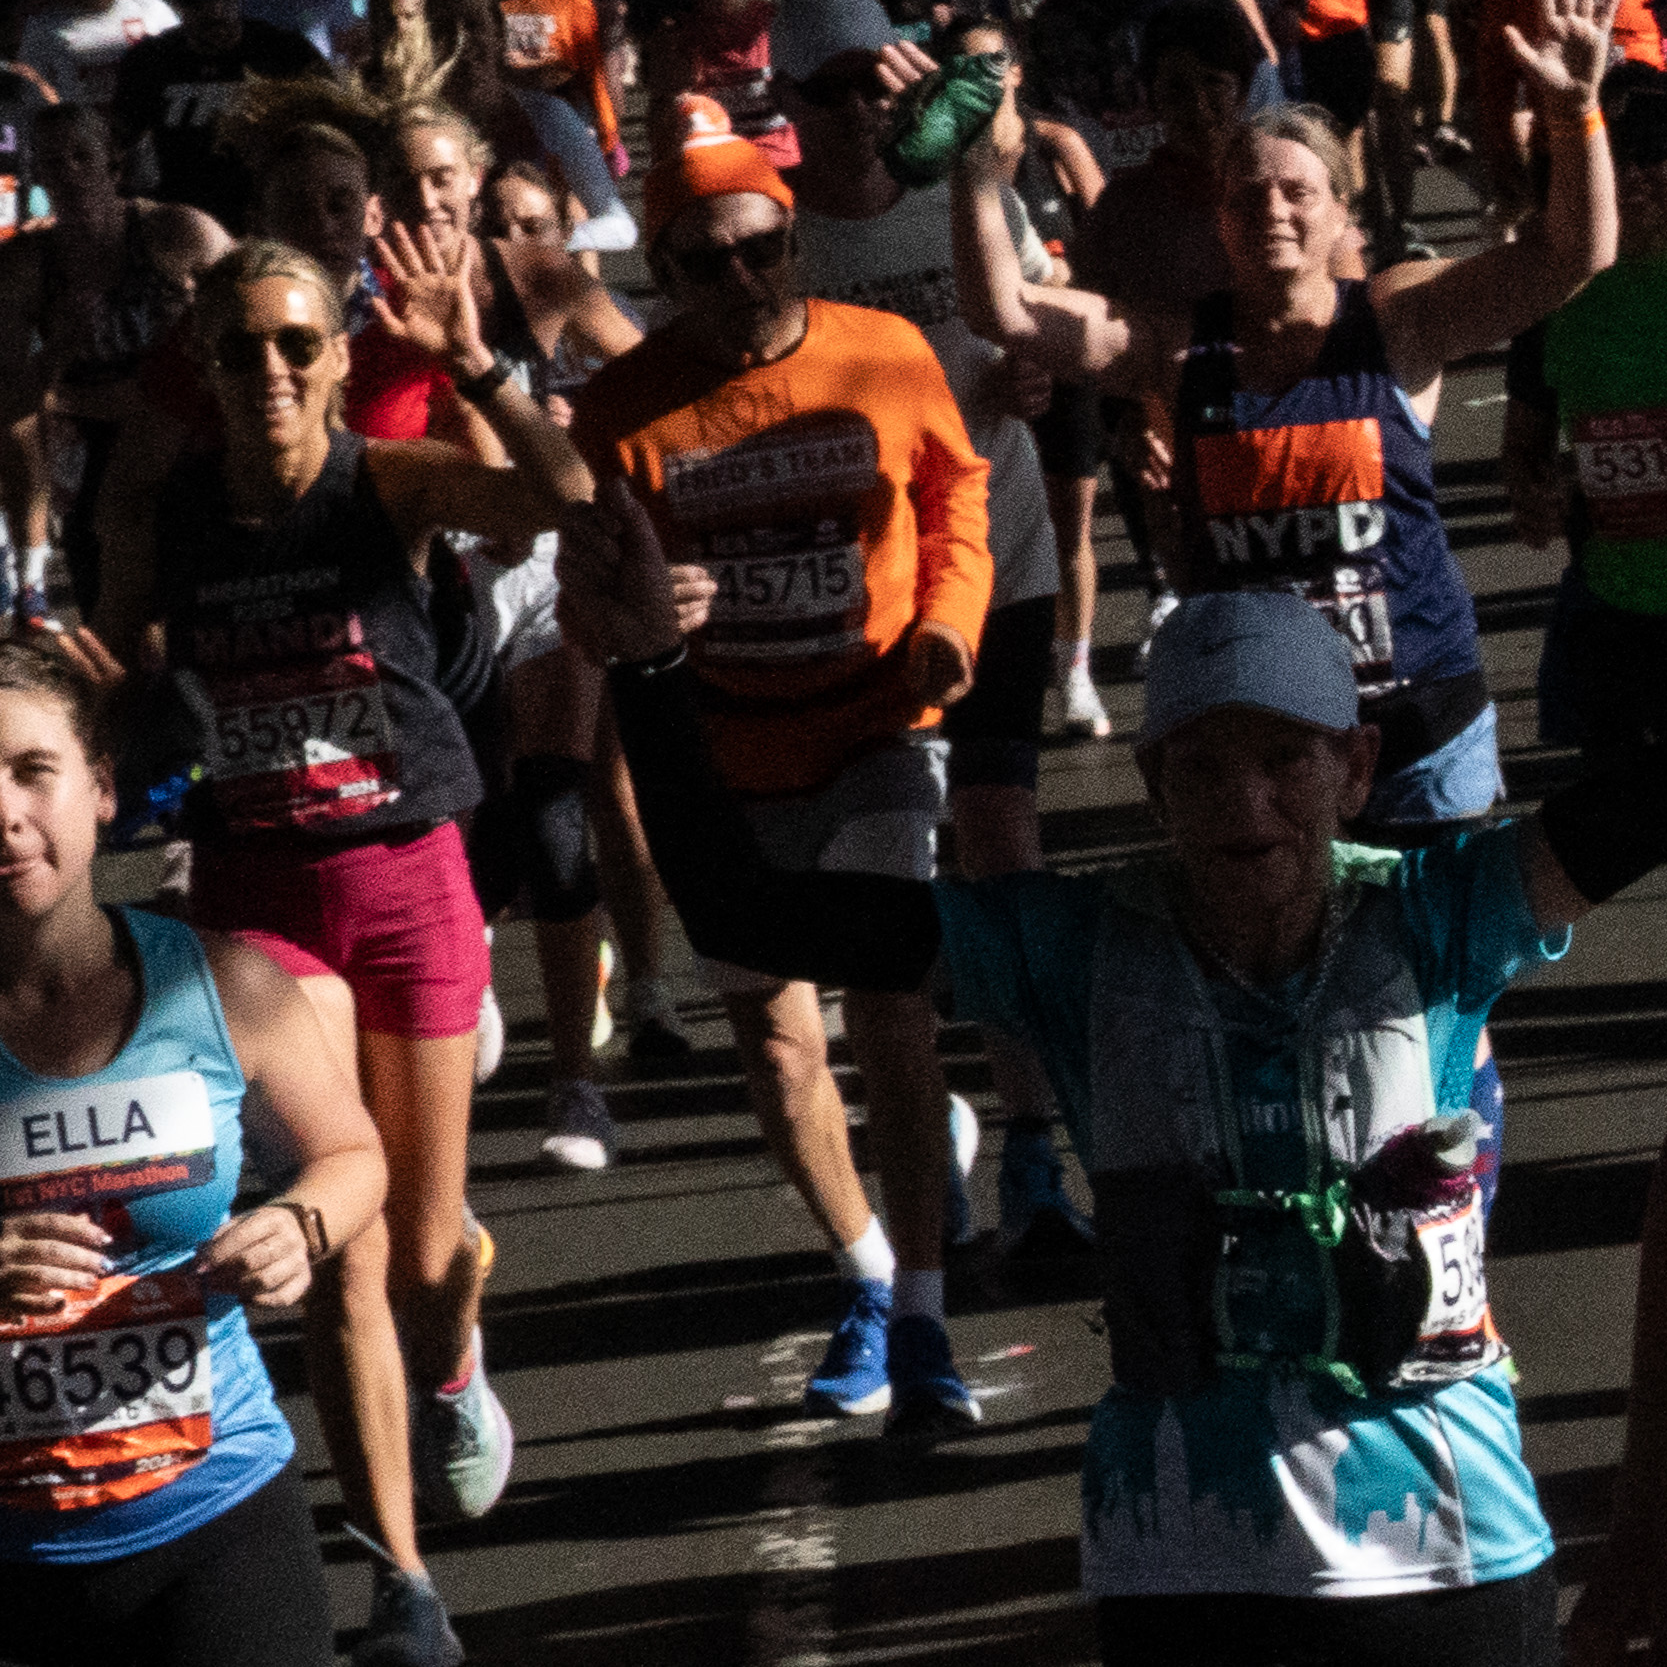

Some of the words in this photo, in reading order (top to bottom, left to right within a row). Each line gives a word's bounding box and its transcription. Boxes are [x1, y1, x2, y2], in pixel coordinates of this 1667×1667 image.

[1206, 500, 1387, 564] NYPD
[717, 552, 852, 606] 45715
[216, 691, 377, 760] 55972
[22, 1099, 156, 1158] ELLA
[39, 1176, 88, 1201] NYC
[92, 1160, 191, 1193] Marathon
